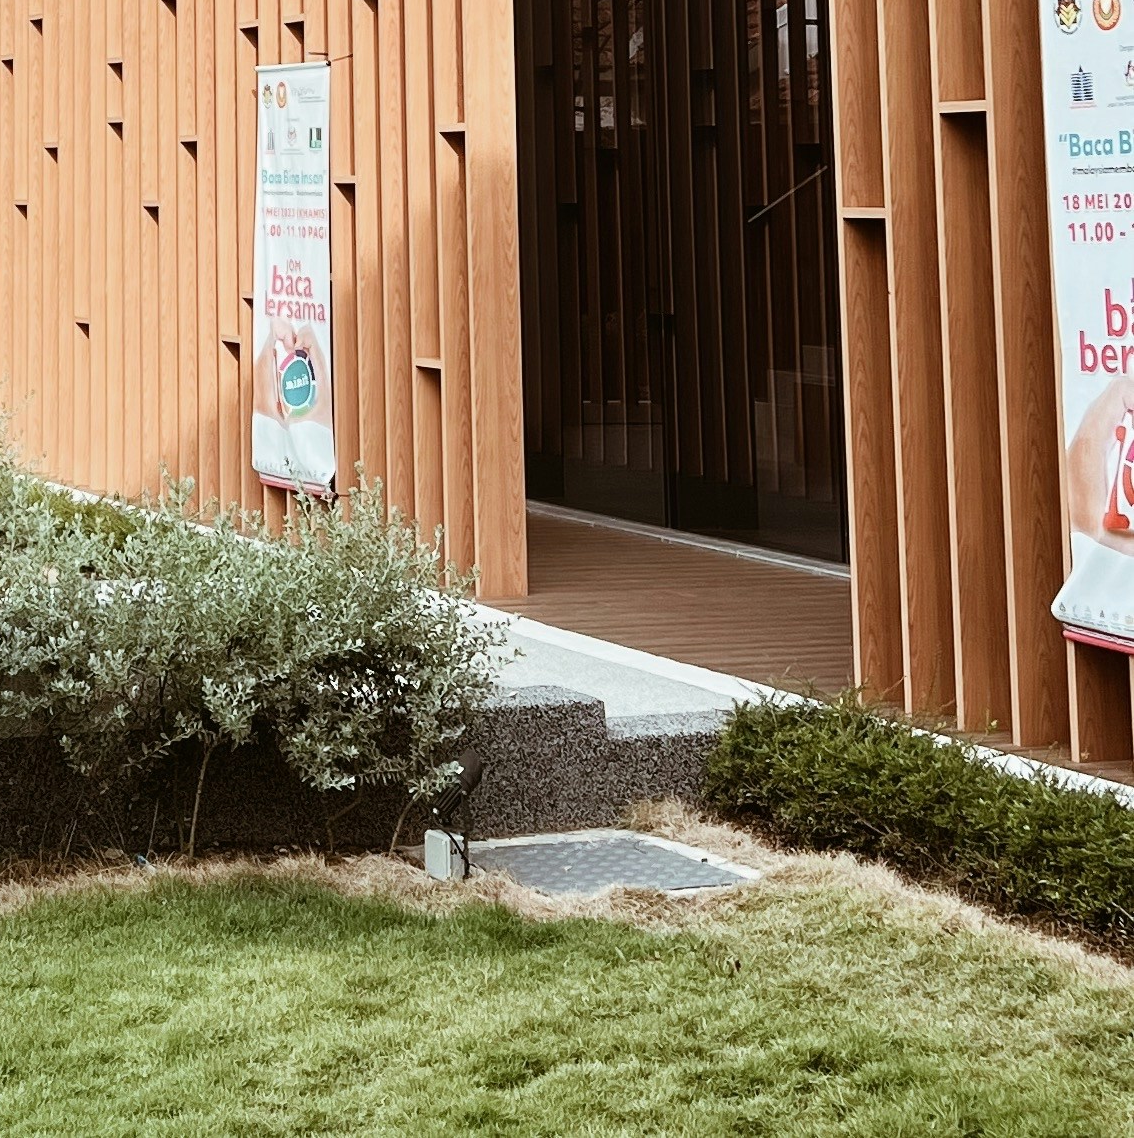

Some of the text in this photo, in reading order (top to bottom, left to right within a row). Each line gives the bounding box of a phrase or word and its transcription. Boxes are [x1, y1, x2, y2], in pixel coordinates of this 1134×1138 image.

[1063, 193, 1134, 210] 18 MEI 20
[1068, 222, 1114, 242] 11.00
[272, 265, 313, 298] baca
